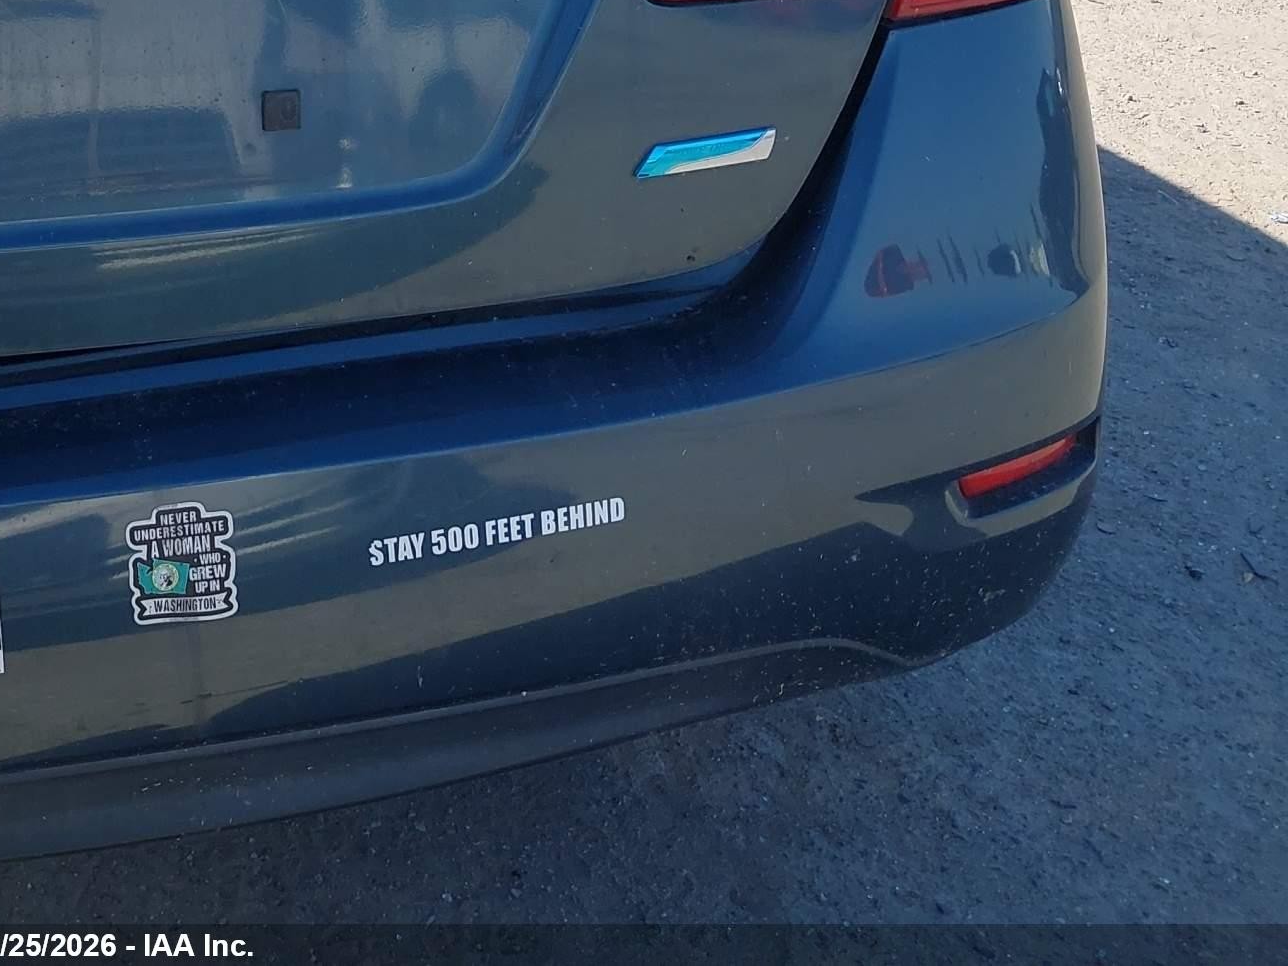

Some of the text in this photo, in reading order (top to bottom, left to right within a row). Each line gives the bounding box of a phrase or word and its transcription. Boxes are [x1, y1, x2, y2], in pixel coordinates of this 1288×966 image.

[160, 511, 196, 526] NEVER
[134, 520, 224, 541] UNDERESTIMATE
[368, 497, 625, 566] STAY 500 FEET BEHIND
[151, 534, 211, 558] A WOMAN
[199, 553, 221, 565] WHO
[189, 564, 227, 581] GREW
[195, 580, 220, 594] UP IN
[153, 597, 217, 613] WASHINGTON
